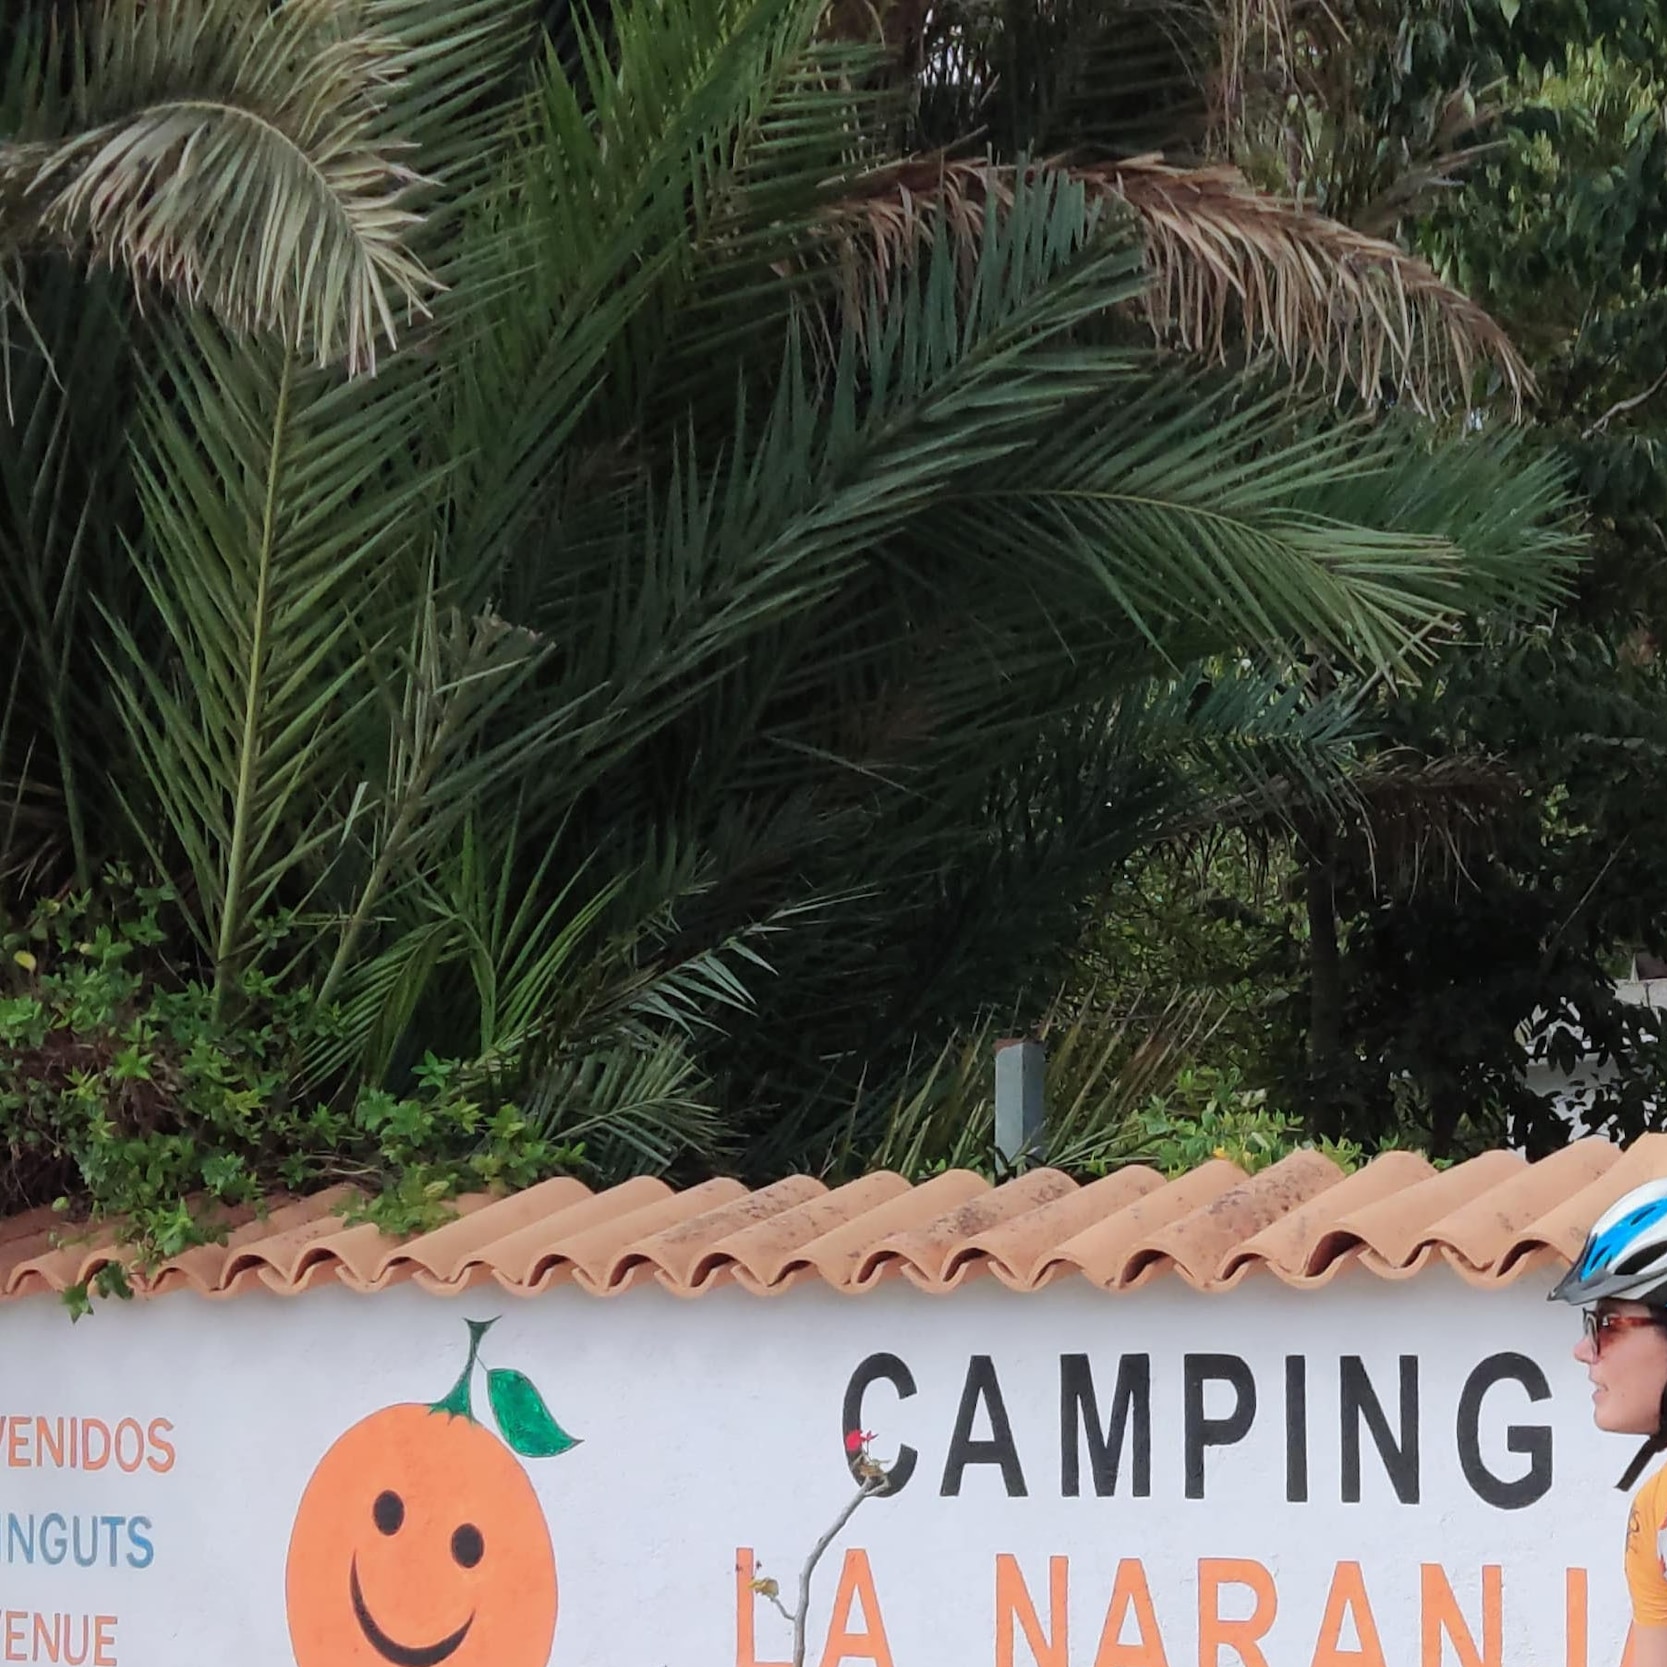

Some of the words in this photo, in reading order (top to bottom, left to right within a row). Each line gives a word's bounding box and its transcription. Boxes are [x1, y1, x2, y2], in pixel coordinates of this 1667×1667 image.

[0, 1415, 176, 1473] ENIDOS
[841, 1351, 1554, 1509] CAMPING
[0, 1609, 118, 1667] ENUE
